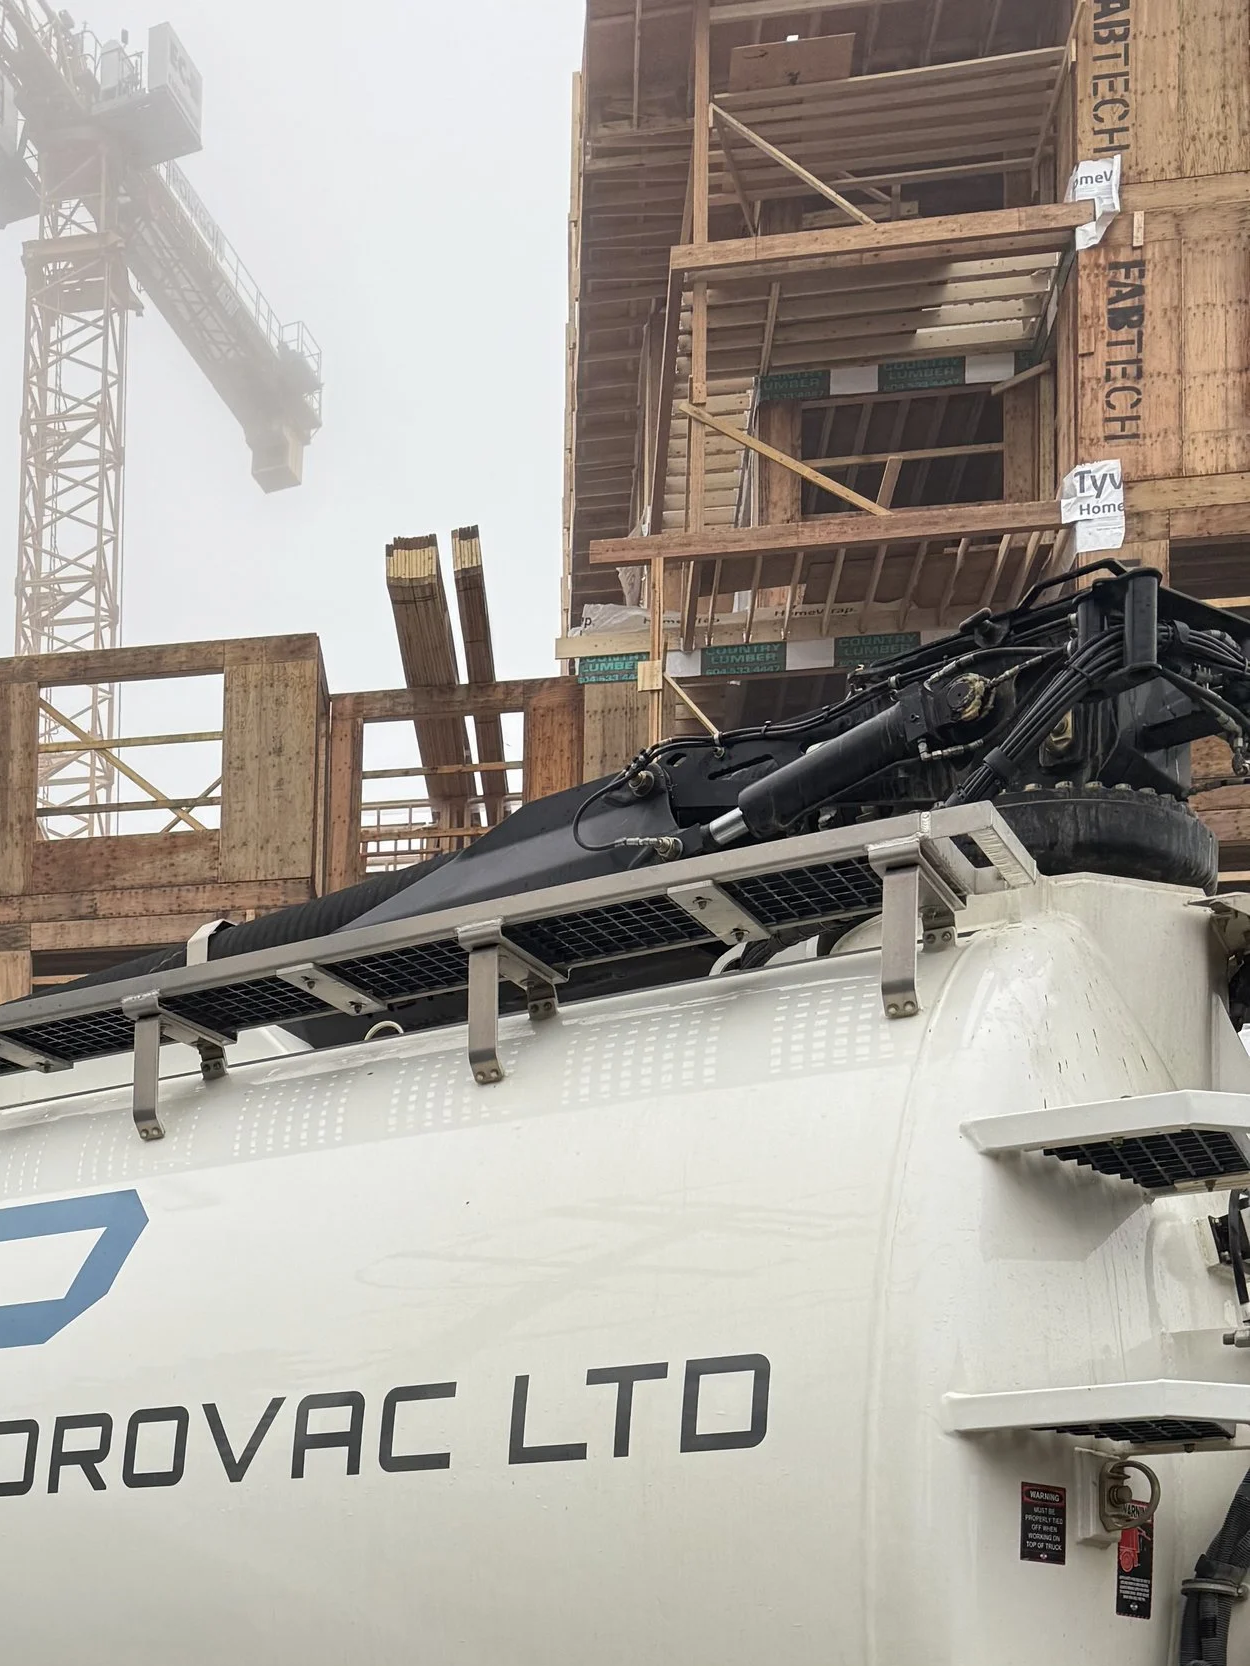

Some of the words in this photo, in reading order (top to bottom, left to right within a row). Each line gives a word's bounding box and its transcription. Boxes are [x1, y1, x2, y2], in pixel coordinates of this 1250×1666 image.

[1103, 259, 1146, 441] FABTECH
[711, 652, 776, 665] LUMBER
[582, 661, 638, 673] LUMBE
[508, 1353, 771, 1465] LTD
[1029, 1490, 1060, 1502] WARNING
